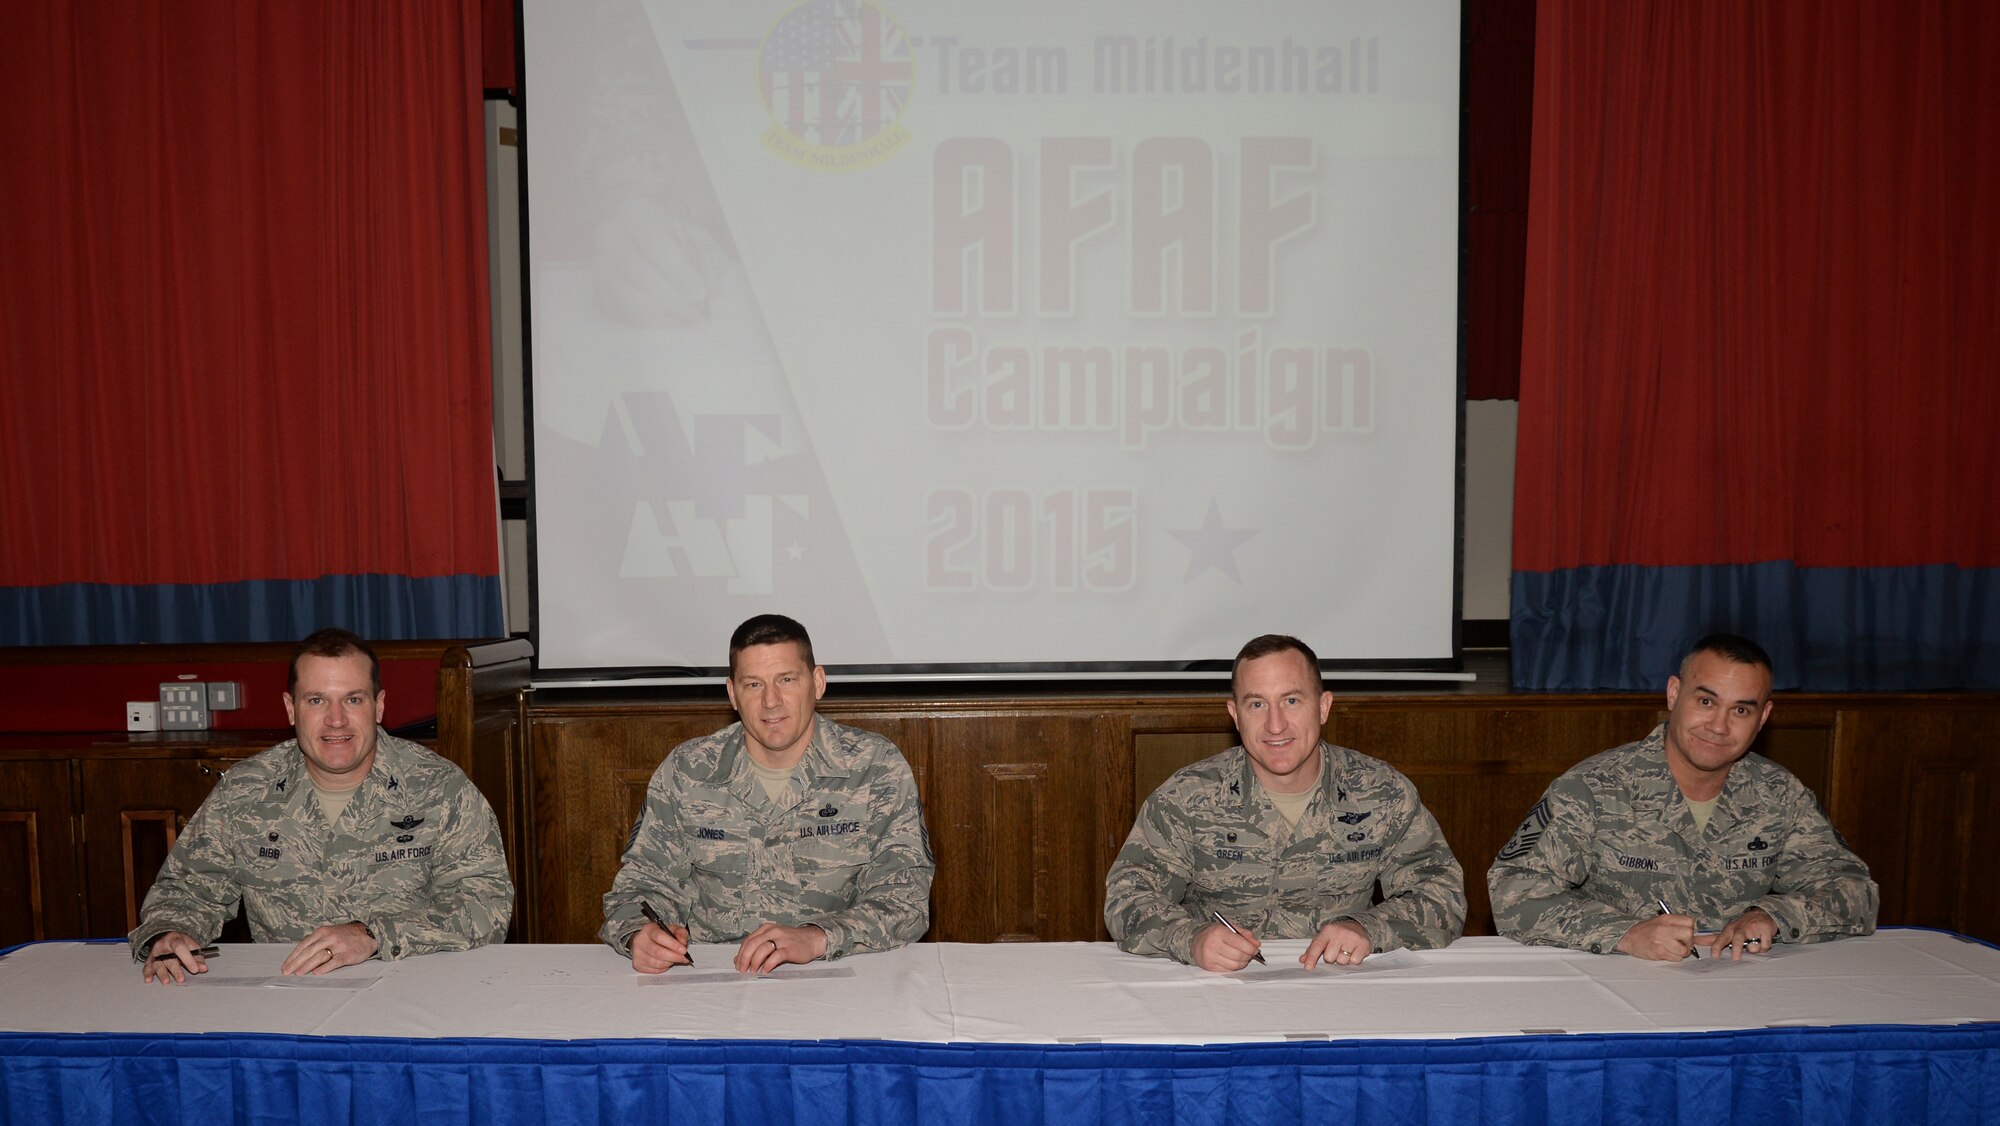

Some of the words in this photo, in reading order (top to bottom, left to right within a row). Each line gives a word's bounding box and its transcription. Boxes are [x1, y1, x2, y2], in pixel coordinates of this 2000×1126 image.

[928, 35, 1068, 95] Team
[1092, 34, 1380, 95] Mildenhall
[767, 130, 808, 160] TEAM
[811, 129, 906, 167] MILDENHALL
[930, 135, 1315, 316] AFAF
[924, 325, 1377, 449] Campaign
[924, 487, 1138, 591] 2015
[697, 826, 725, 840] JONES
[800, 827, 815, 839] U.S.
[816, 825, 829, 837] AIR
[830, 821, 860, 836] FORCE
[258, 846, 280, 860] BIBB
[375, 851, 390, 864] U.S.
[391, 849, 406, 862] AIR
[1216, 849, 1243, 861] GREEN
[1329, 852, 1344, 863] U.S.
[1346, 850, 1360, 862] AIR
[1619, 854, 1659, 871] GIBBONS
[1725, 858, 1741, 870] U.S.
[1742, 857, 1758, 869] AIR
